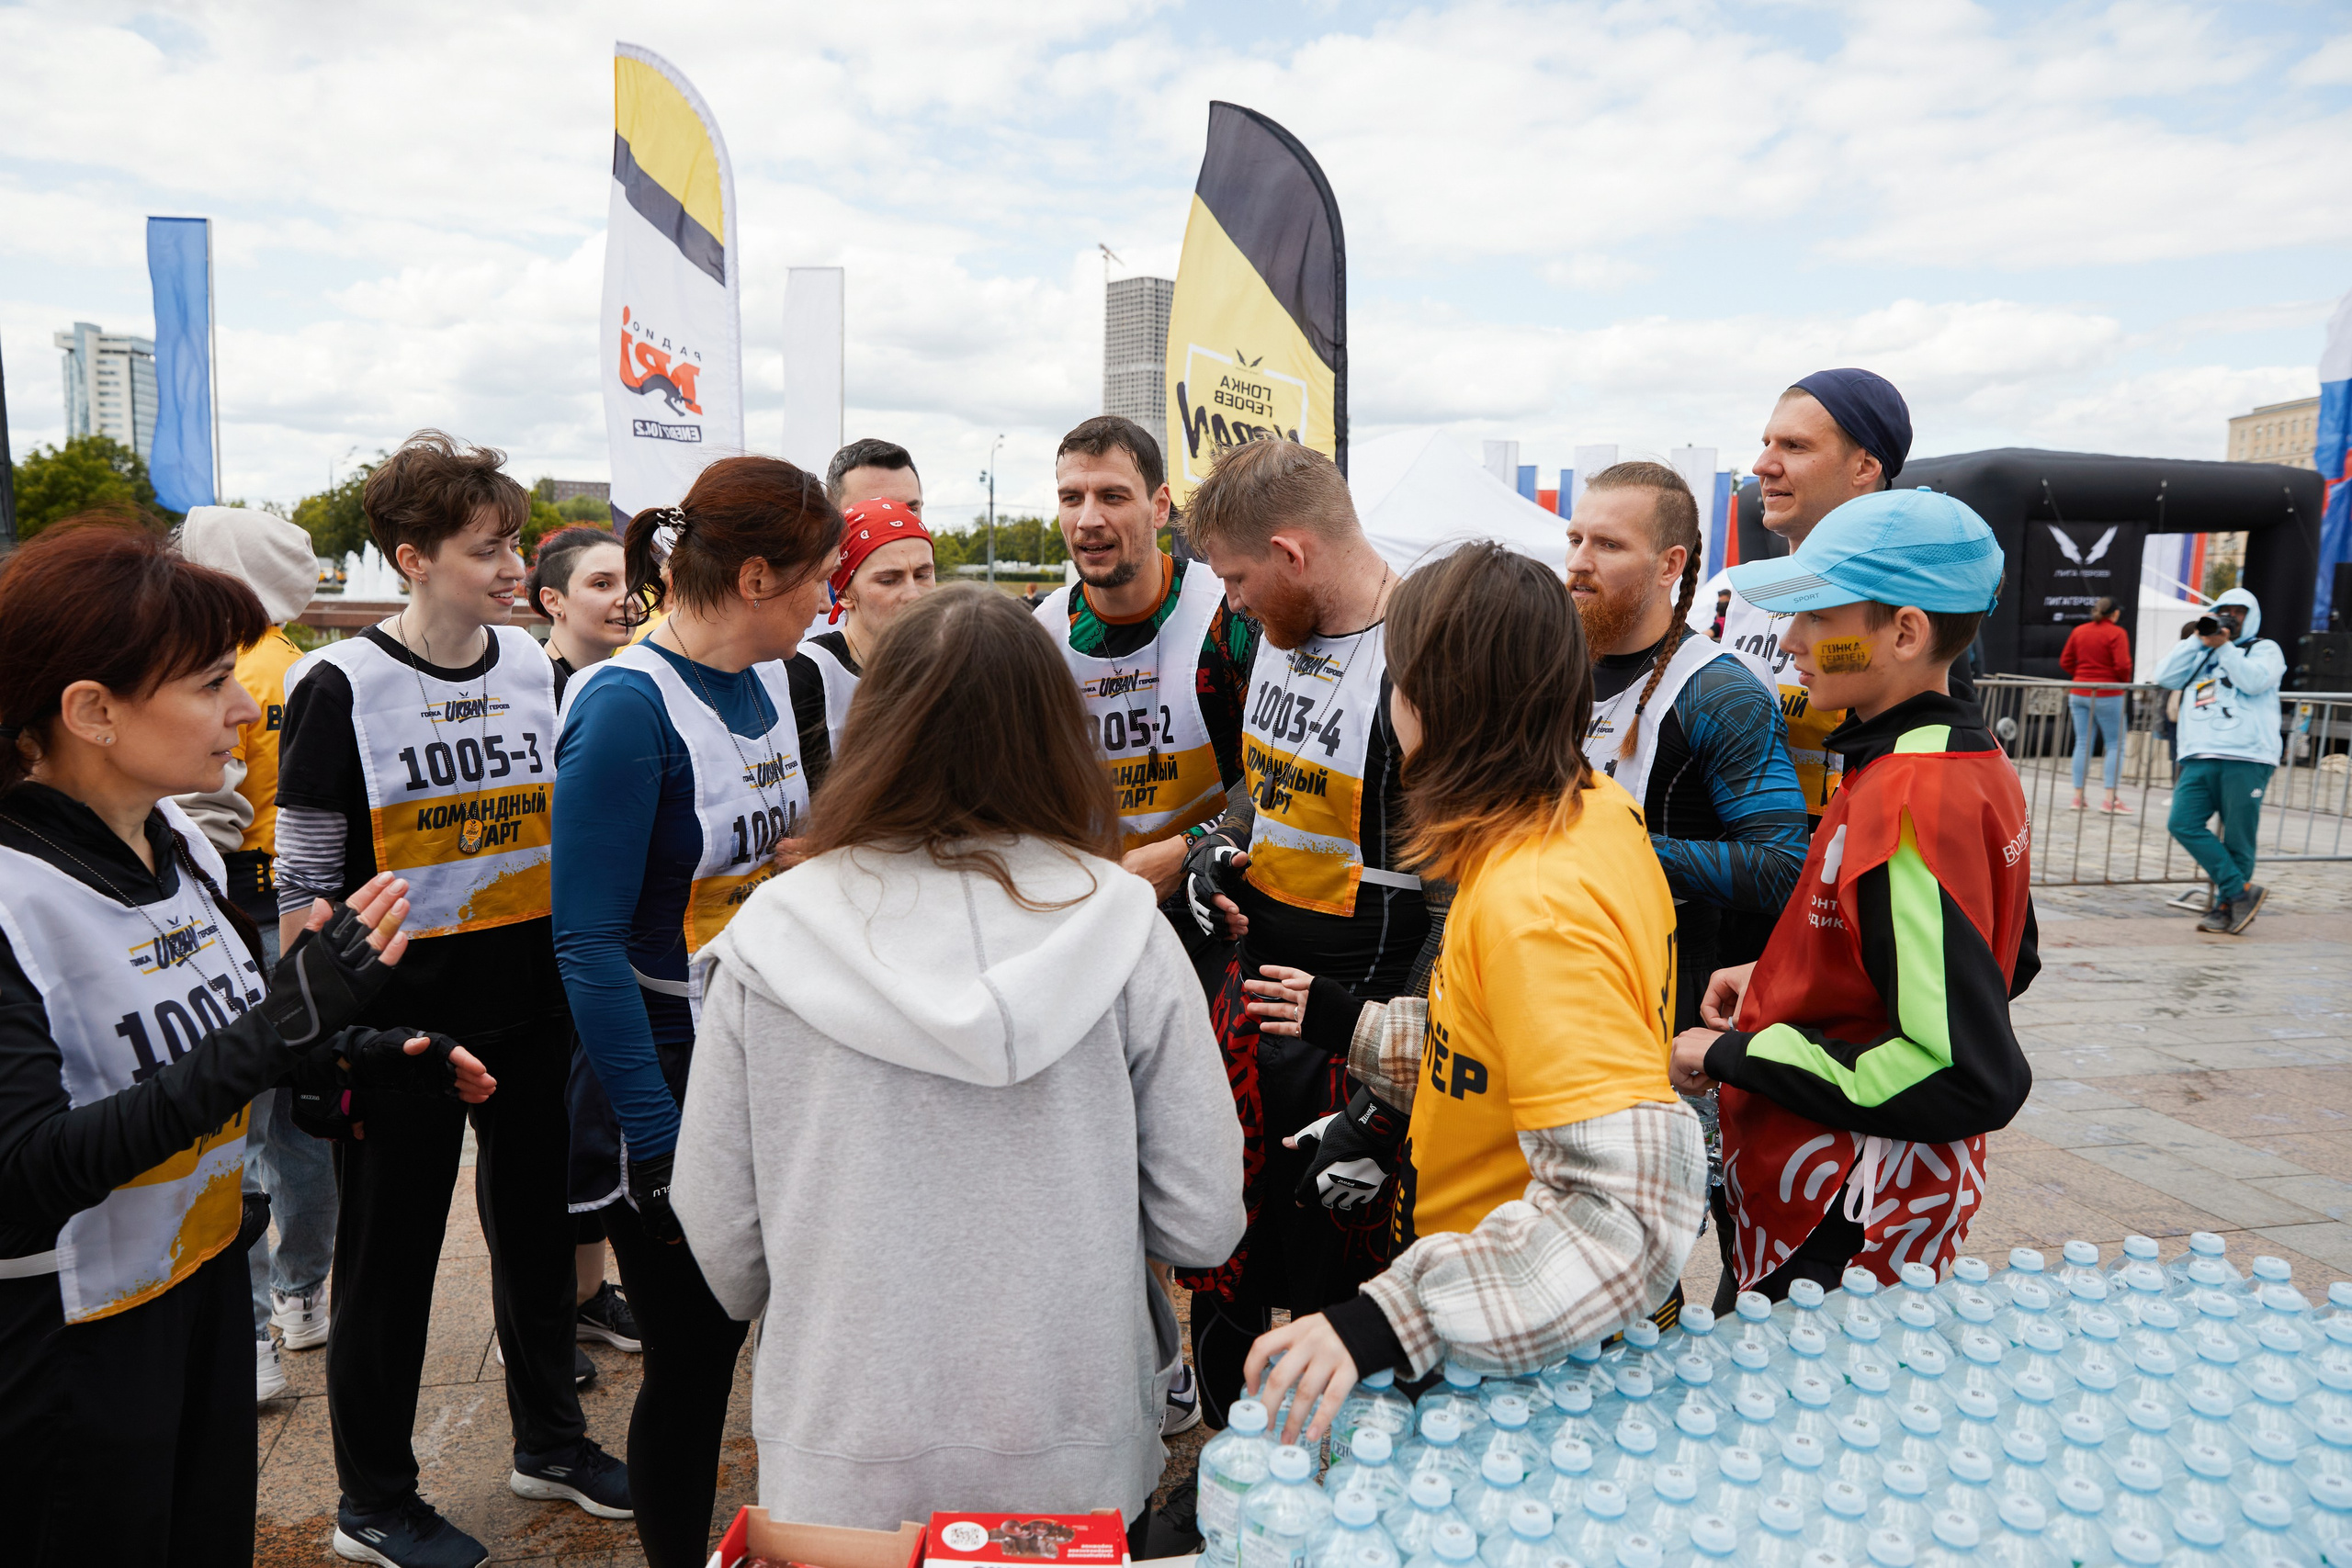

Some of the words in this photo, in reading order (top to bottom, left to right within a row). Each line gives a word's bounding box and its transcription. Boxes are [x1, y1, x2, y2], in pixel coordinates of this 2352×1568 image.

[1793, 592, 1820, 604] SPORT
[1822, 641, 1862, 655] ГОНКА
[1099, 669, 1139, 698] URBAN
[445, 694, 487, 723] URBAN
[1250, 681, 1344, 757] 1003-4
[399, 733, 543, 791] 1005-3
[417, 785, 547, 830] КОМАНДНЫЙ
